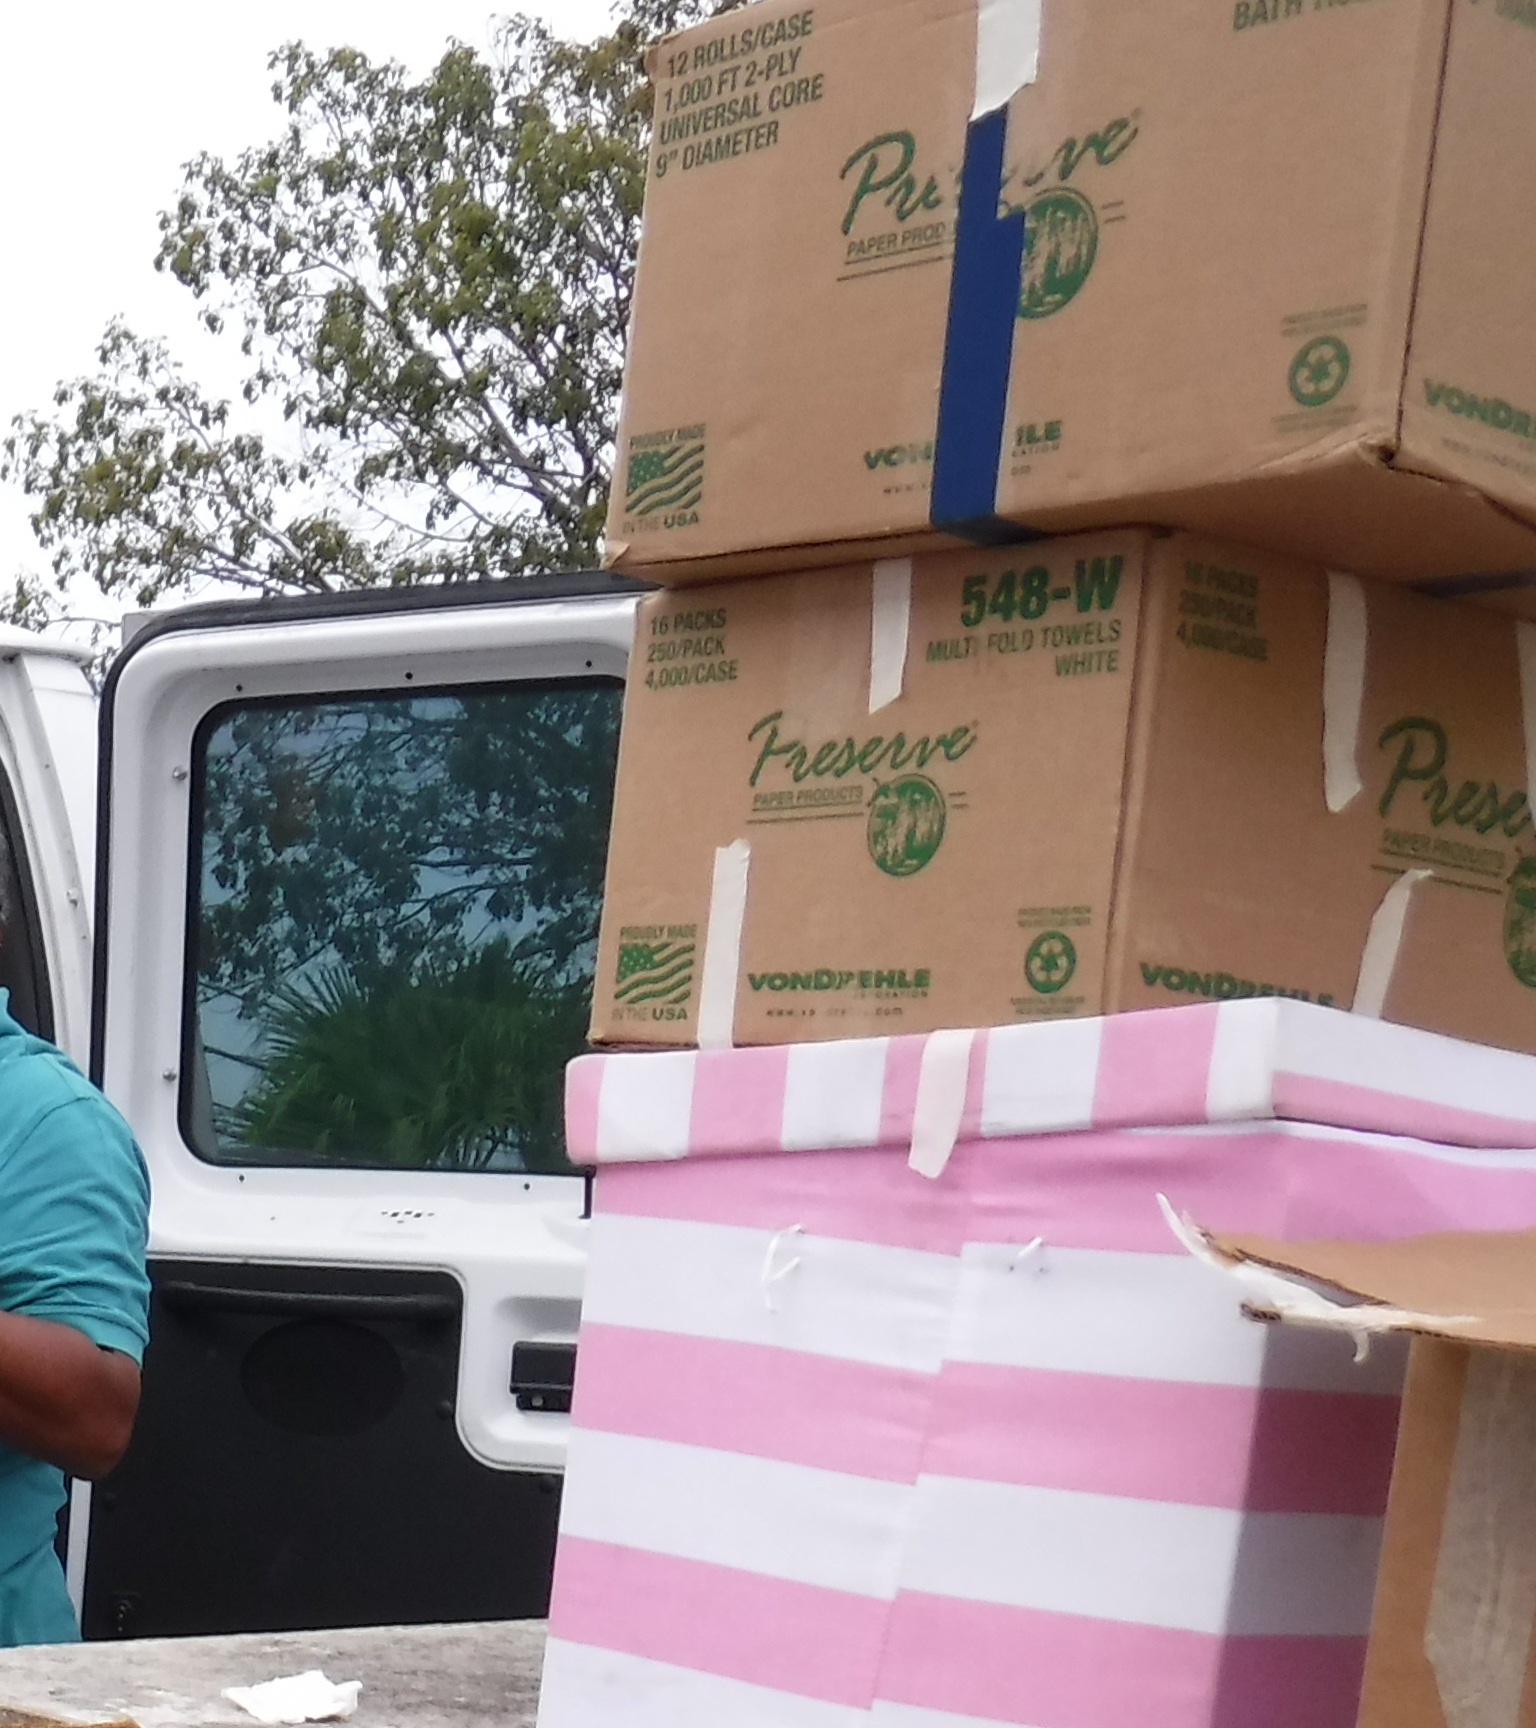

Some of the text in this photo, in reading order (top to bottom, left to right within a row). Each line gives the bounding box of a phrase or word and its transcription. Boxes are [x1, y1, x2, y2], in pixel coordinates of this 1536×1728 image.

[668, 10, 814, 78] 12 ROLLS/CASE
[665, 47, 802, 113] 1,000 FT 2-PLY
[660, 73, 824, 145] UNIVERSAL CORE
[682, 121, 779, 170] DIAMETER
[847, 232, 898, 256] PAPER
[664, 511, 699, 529] USA
[960, 554, 1124, 628] 548-W
[673, 608, 727, 632] PACKS
[988, 628, 1034, 654] FOLD
[1041, 618, 1122, 649] TOWELS
[647, 635, 725, 663] 250/PACK
[1055, 650, 1119, 677] WHITE
[748, 711, 977, 787] Preserve
[652, 1006, 688, 1021] USA
